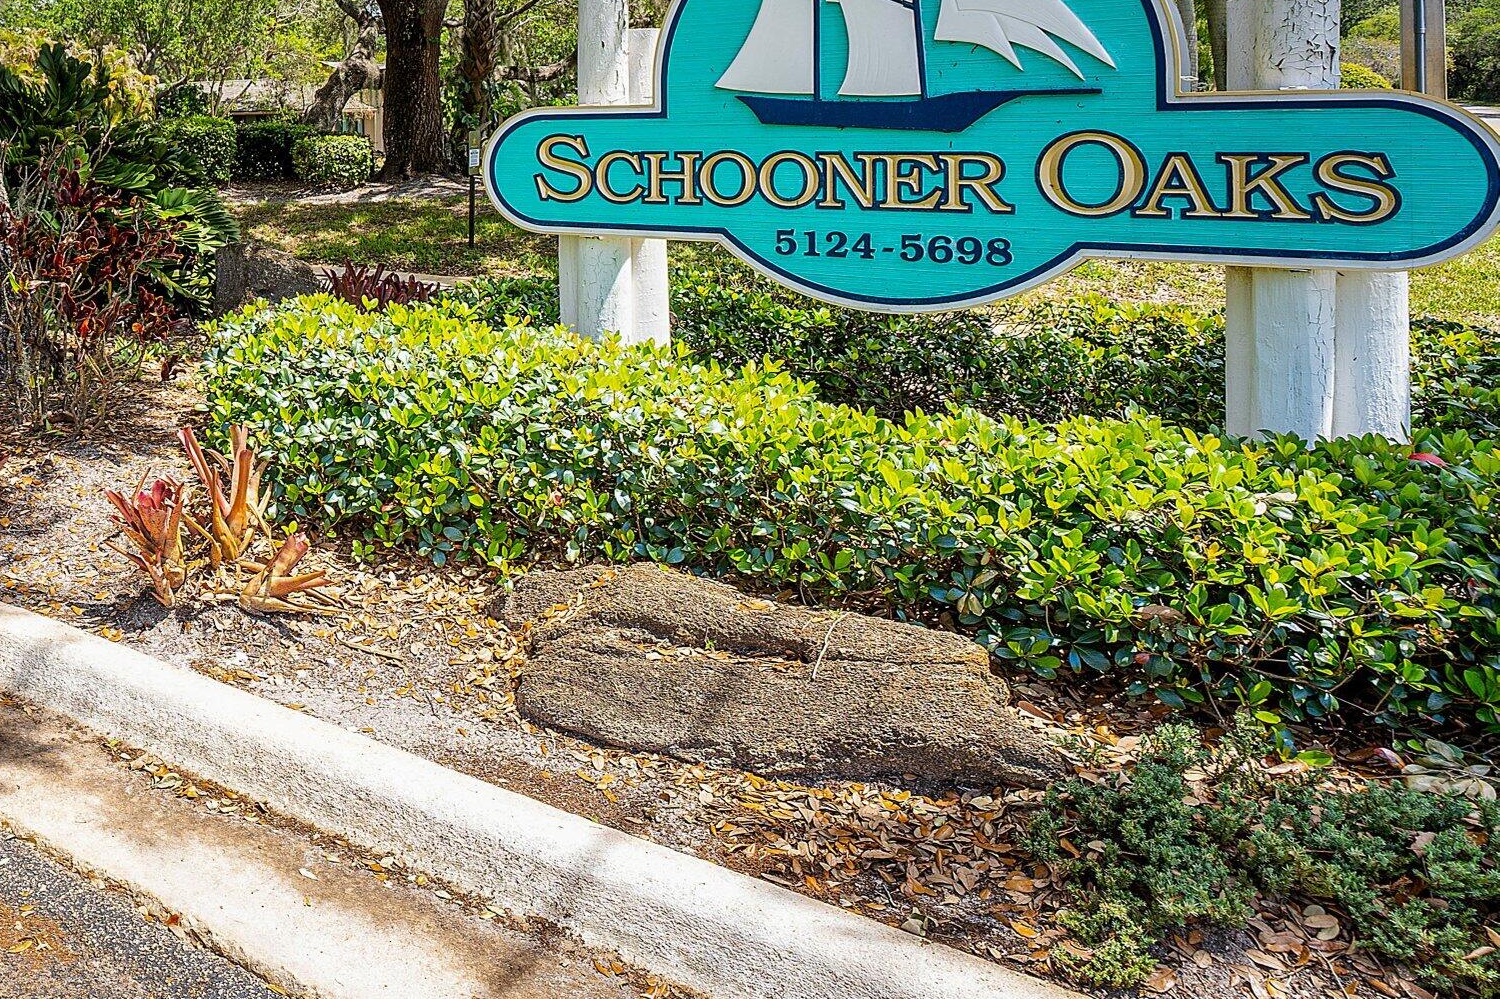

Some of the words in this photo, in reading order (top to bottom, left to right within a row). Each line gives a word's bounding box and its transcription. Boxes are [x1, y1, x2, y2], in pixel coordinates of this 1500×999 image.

[533, 133, 1016, 215] SCHOONER
[1035, 129, 1402, 226] OAKS
[774, 229, 1014, 266] 5124-5698
